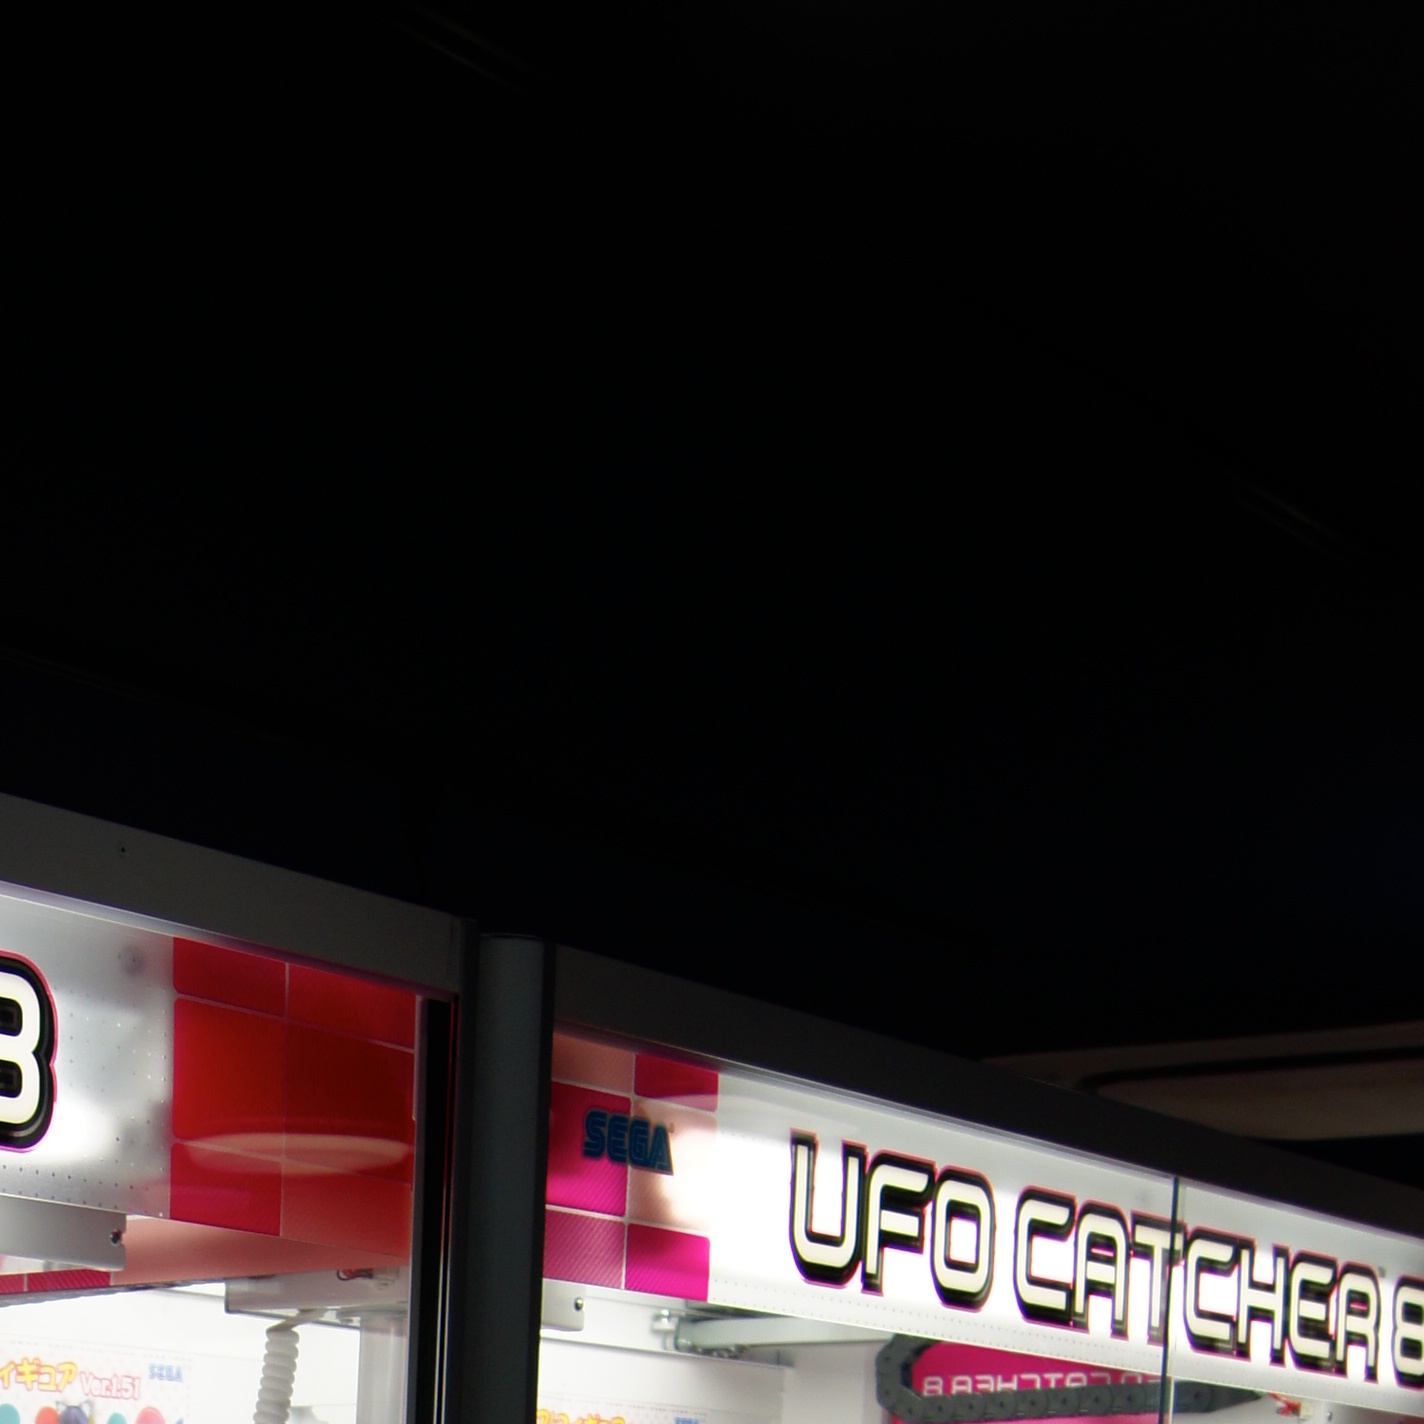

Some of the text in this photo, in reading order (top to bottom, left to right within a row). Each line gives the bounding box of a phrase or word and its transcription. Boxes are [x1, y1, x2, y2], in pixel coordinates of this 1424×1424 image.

[582, 1107, 674, 1176] SEGA
[789, 1128, 996, 1312] UFO
[1012, 1184, 1382, 1386] CATCHER
[79, 1370, 141, 1401] Ver.1.51
[148, 1362, 184, 1382] SEGA
